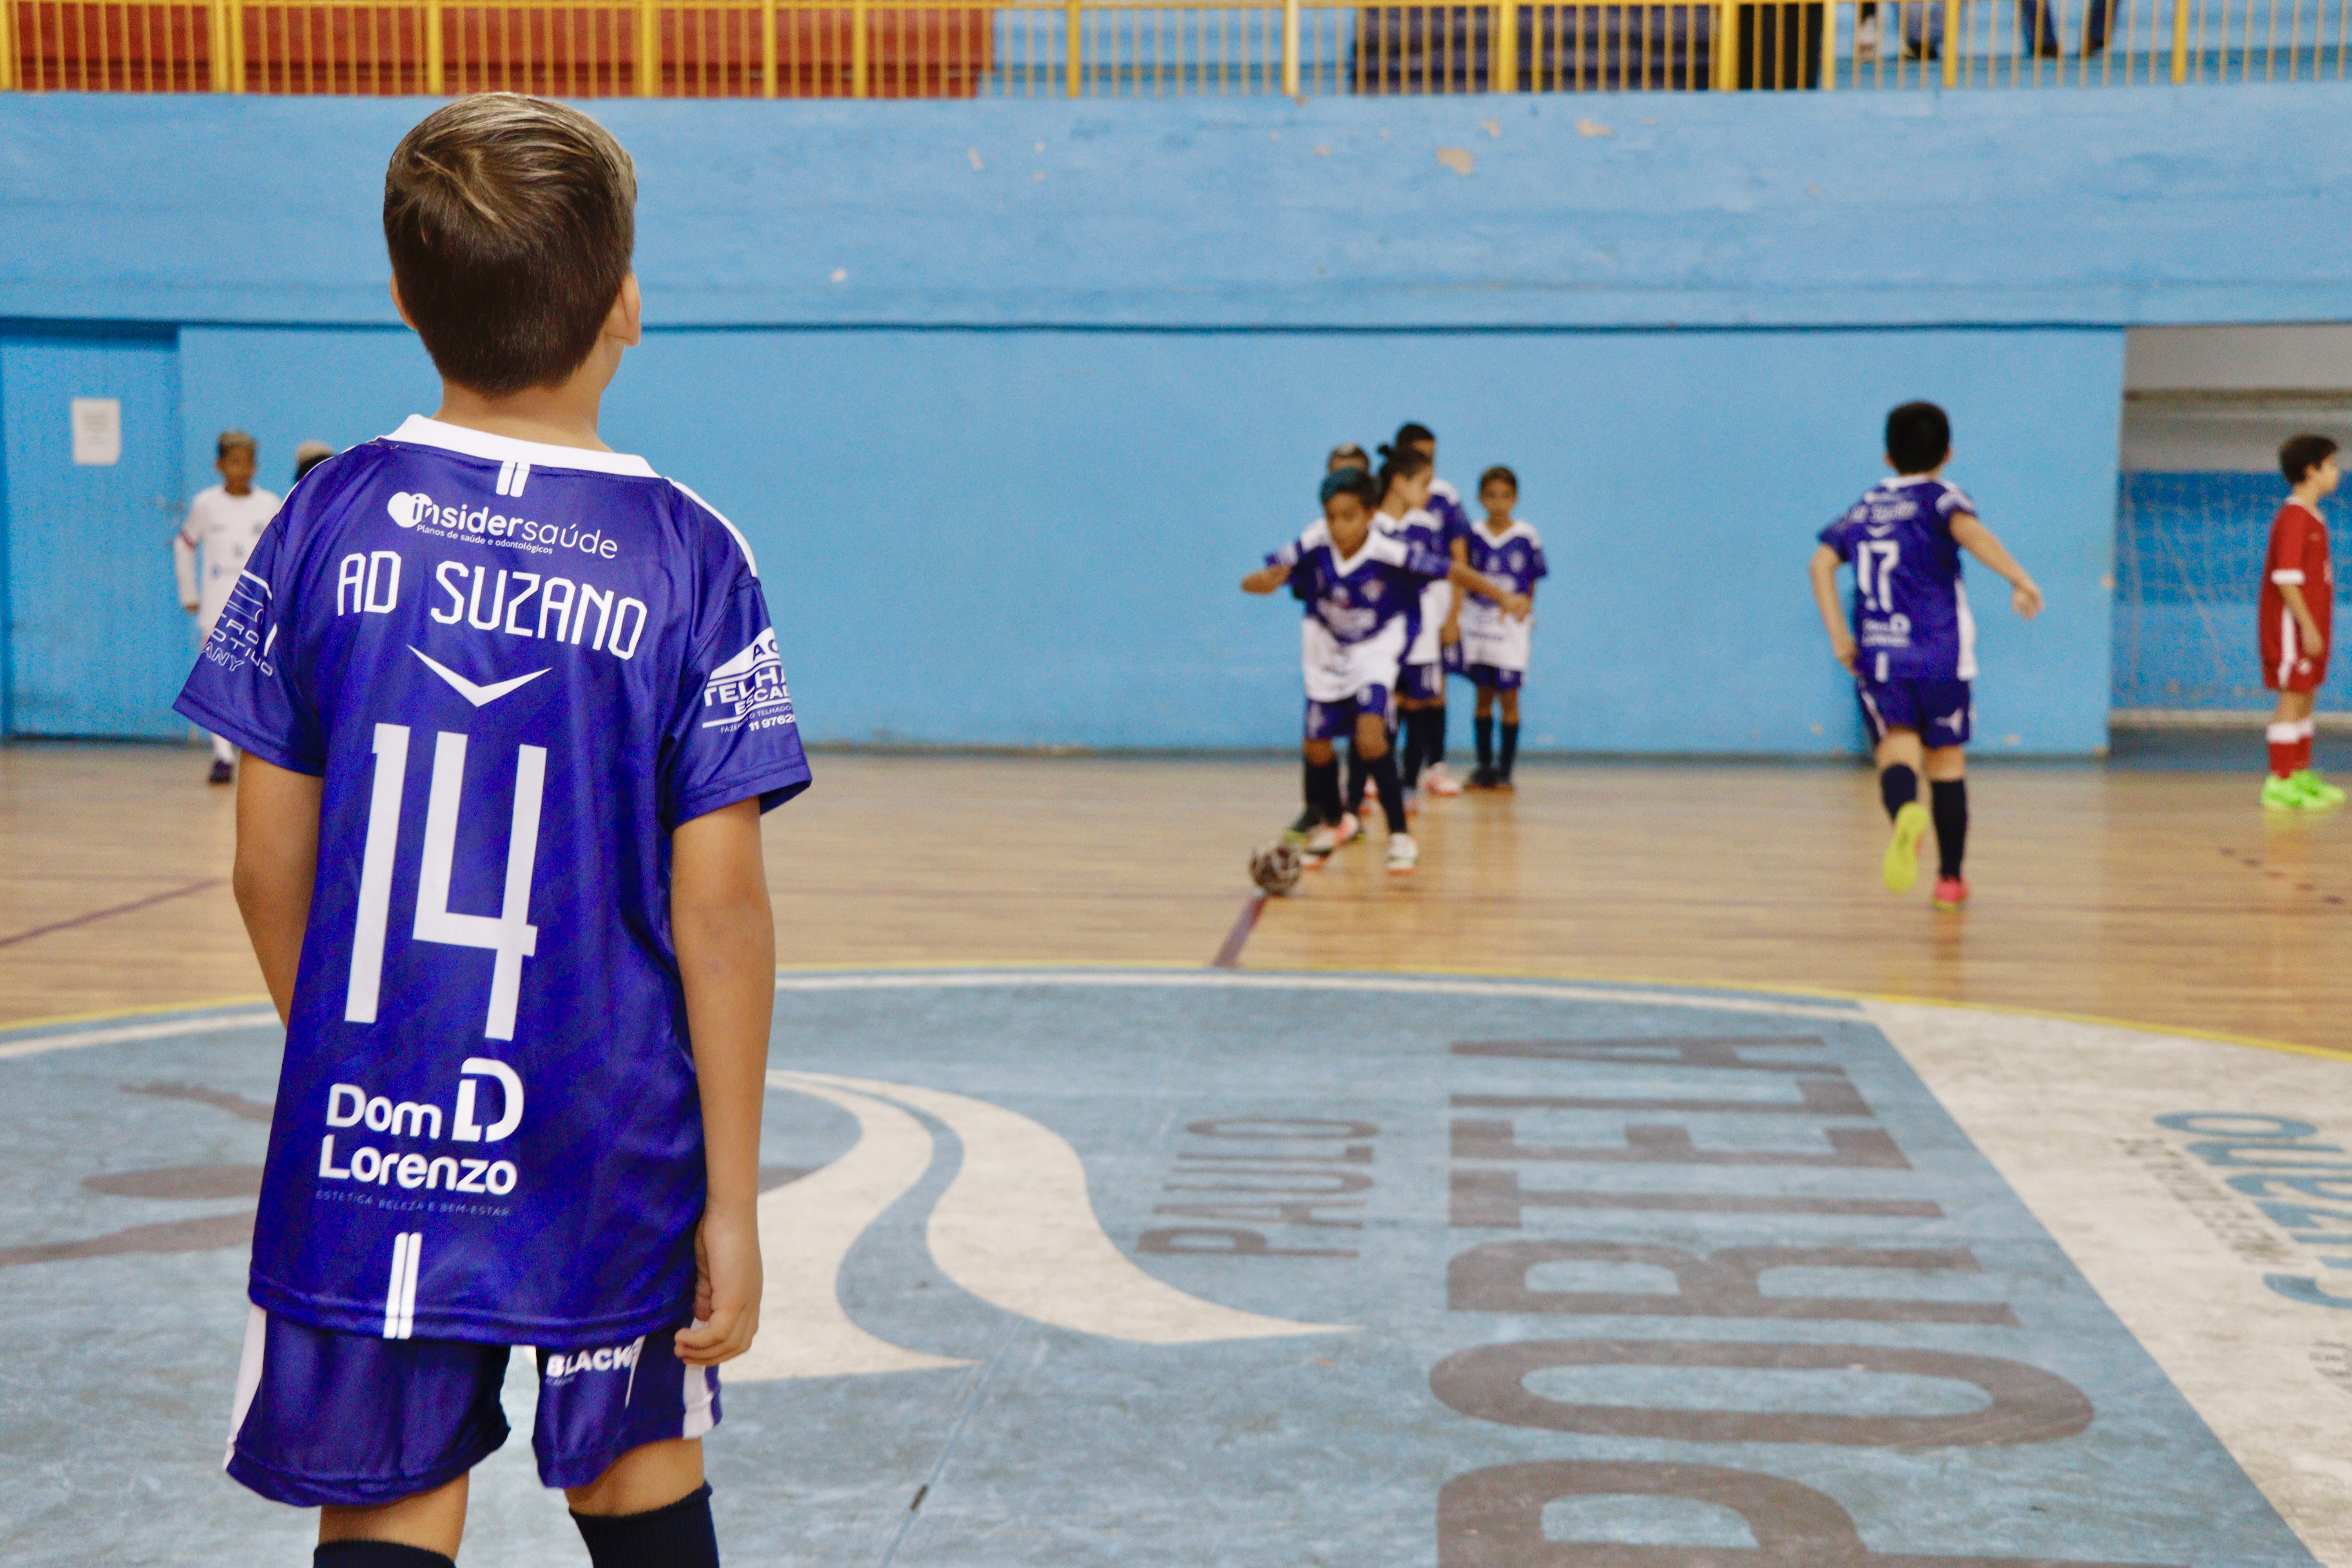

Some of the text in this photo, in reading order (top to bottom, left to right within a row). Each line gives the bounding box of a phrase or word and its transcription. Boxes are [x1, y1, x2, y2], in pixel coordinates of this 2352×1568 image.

[417, 524, 445, 536] Planos
[447, 531, 459, 539] de
[460, 534, 486, 544] saúde
[495, 539, 553, 554] odontológicos
[1857, 539, 1900, 612] 17
[338, 551, 647, 660] AD SUZANO
[749, 720, 760, 731] 11
[344, 722, 547, 1041] 14
[326, 1083, 442, 1139] Dom
[319, 1134, 517, 1195] Lorenzo
[1136, 1116, 1379, 1258] PAULO
[1428, 1035, 2191, 1568] PORTELA
